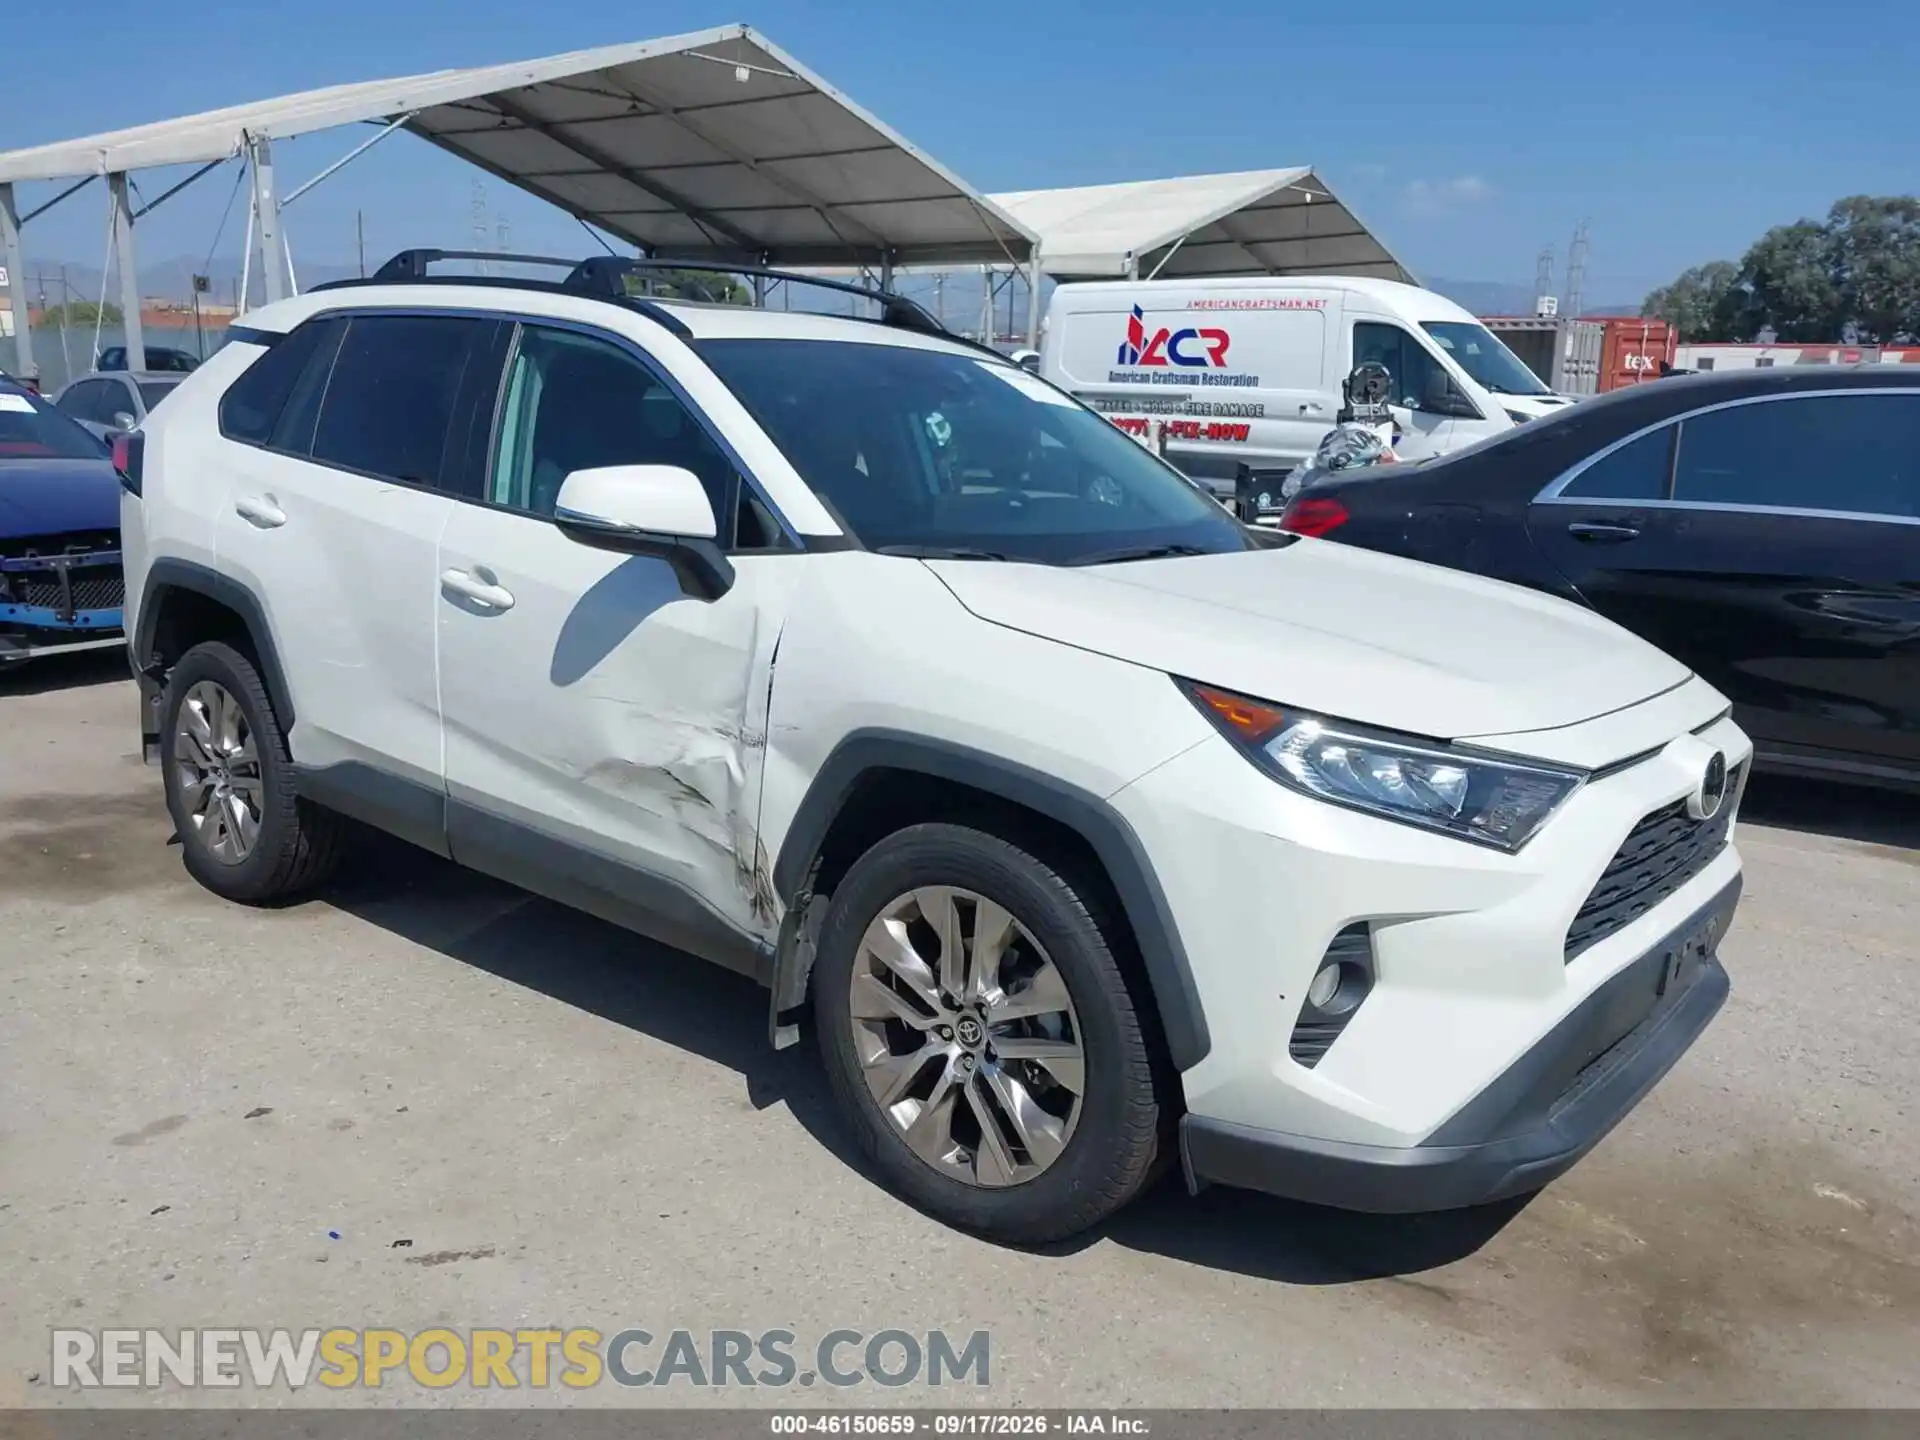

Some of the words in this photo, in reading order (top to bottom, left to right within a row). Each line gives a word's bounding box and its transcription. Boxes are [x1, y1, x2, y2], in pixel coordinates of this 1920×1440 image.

[1186, 299, 1328, 309] AMERICANCRAFTSMAN.NET
[1139, 328, 1231, 368] ACR
[1624, 352, 1655, 370] tex
[1108, 370, 1150, 384] American
[1152, 371, 1200, 386] Craftsman
[1202, 372, 1259, 387] Restoration
[1184, 402, 1211, 416] FIRE
[1213, 403, 1264, 417] DAMAGE
